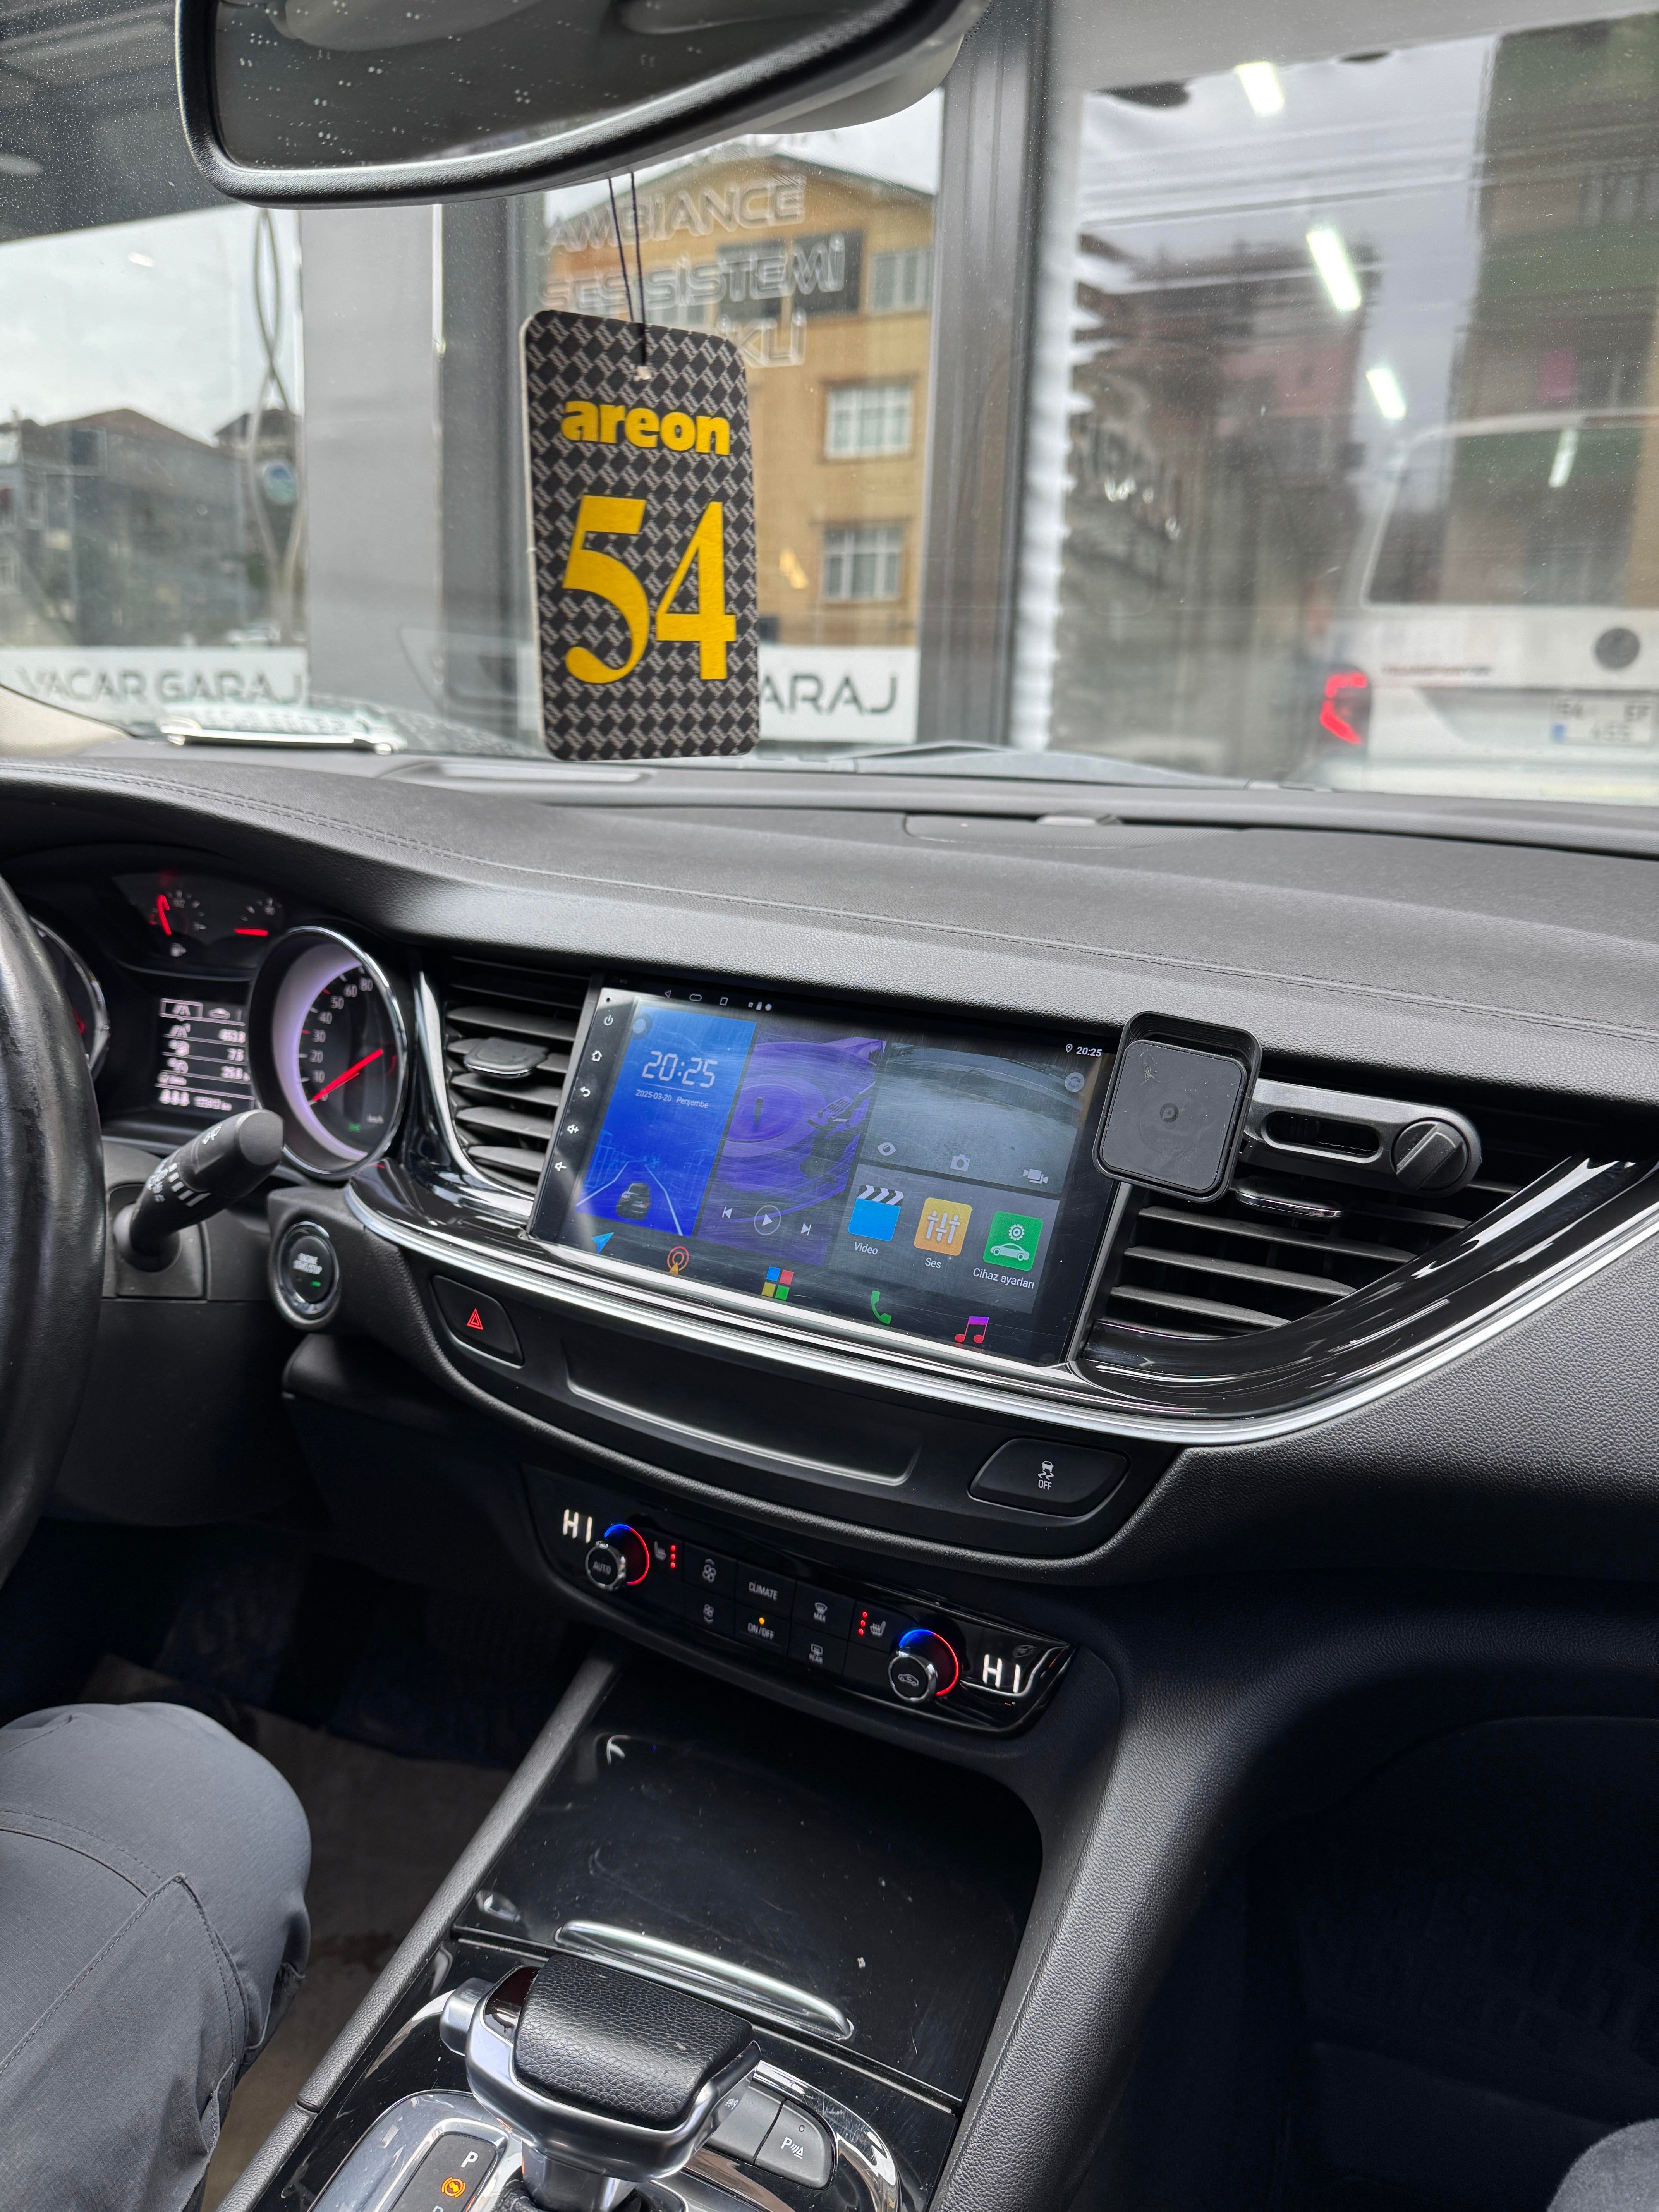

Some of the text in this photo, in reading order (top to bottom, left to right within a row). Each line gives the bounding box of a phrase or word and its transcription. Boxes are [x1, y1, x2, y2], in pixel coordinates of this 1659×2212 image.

[536, 179, 805, 255] AMBIANCE
[561, 401, 730, 456] areon
[562, 495, 736, 684] 54
[156, 668, 304, 708] GARAJ
[343, 984, 357, 998] 60
[359, 977, 373, 991] 80
[330, 995, 344, 1009] 50
[318, 1011, 332, 1024] 40
[311, 1029, 326, 1043] 30
[309, 1049, 323, 1063] 20
[1076, 1046, 1103, 1057] 20:25
[313, 1070, 325, 1083] 10
[642, 1051, 718, 1088] 20:25
[636, 1089, 709, 1108] 2025-03-20 Perşembe
[854, 1242, 878, 1255] Video
[925, 1257, 941, 1269] Ses
[973, 1267, 1035, 1290] Cihaz ayarları
[1038, 1479, 1052, 1491] OFF
[563, 1509, 592, 1543] HI
[592, 1561, 611, 1576] AUTO
[748, 1582, 778, 1601] CLIMATE
[813, 1612, 826, 1623] MAX
[747, 1622, 775, 1640] ON/OFF
[982, 1654, 1021, 1694] HI
[461, 2151, 478, 2168] P
